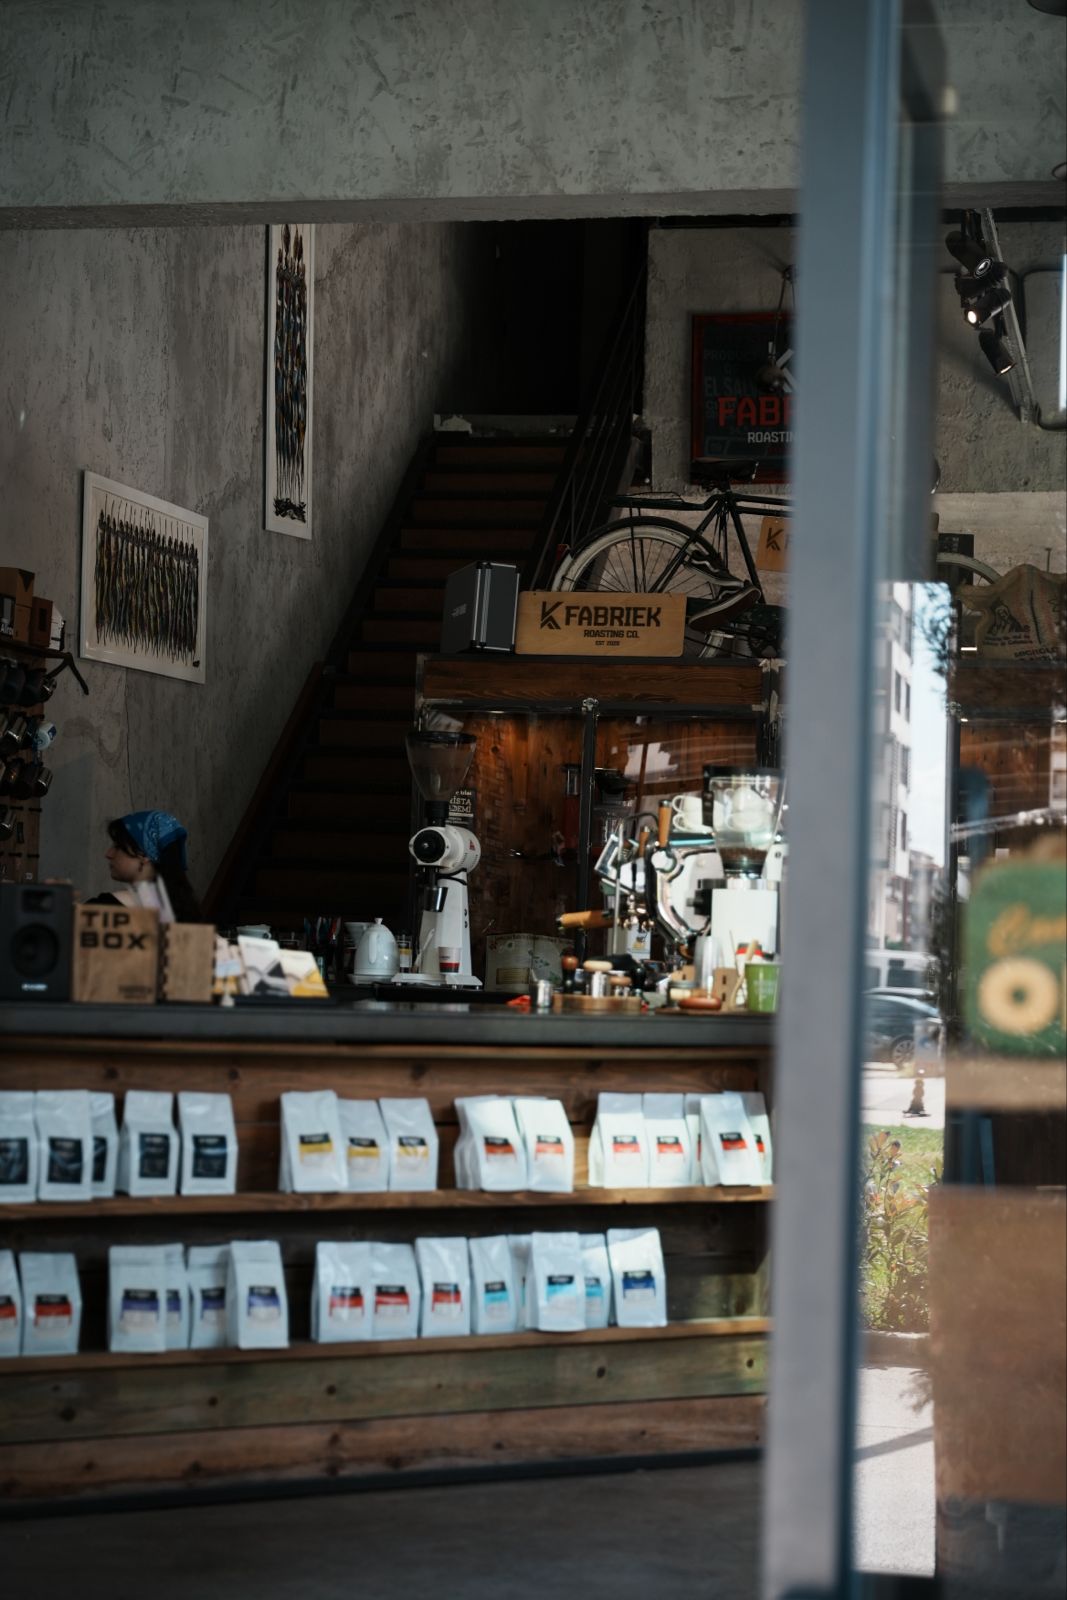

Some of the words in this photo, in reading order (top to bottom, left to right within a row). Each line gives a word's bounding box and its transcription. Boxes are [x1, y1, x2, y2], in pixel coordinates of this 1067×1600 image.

[565, 606, 662, 628] FABRIEK
[583, 629, 625, 638] ROASTING
[81, 911, 130, 928] TIP
[80, 931, 147, 950] BOX
